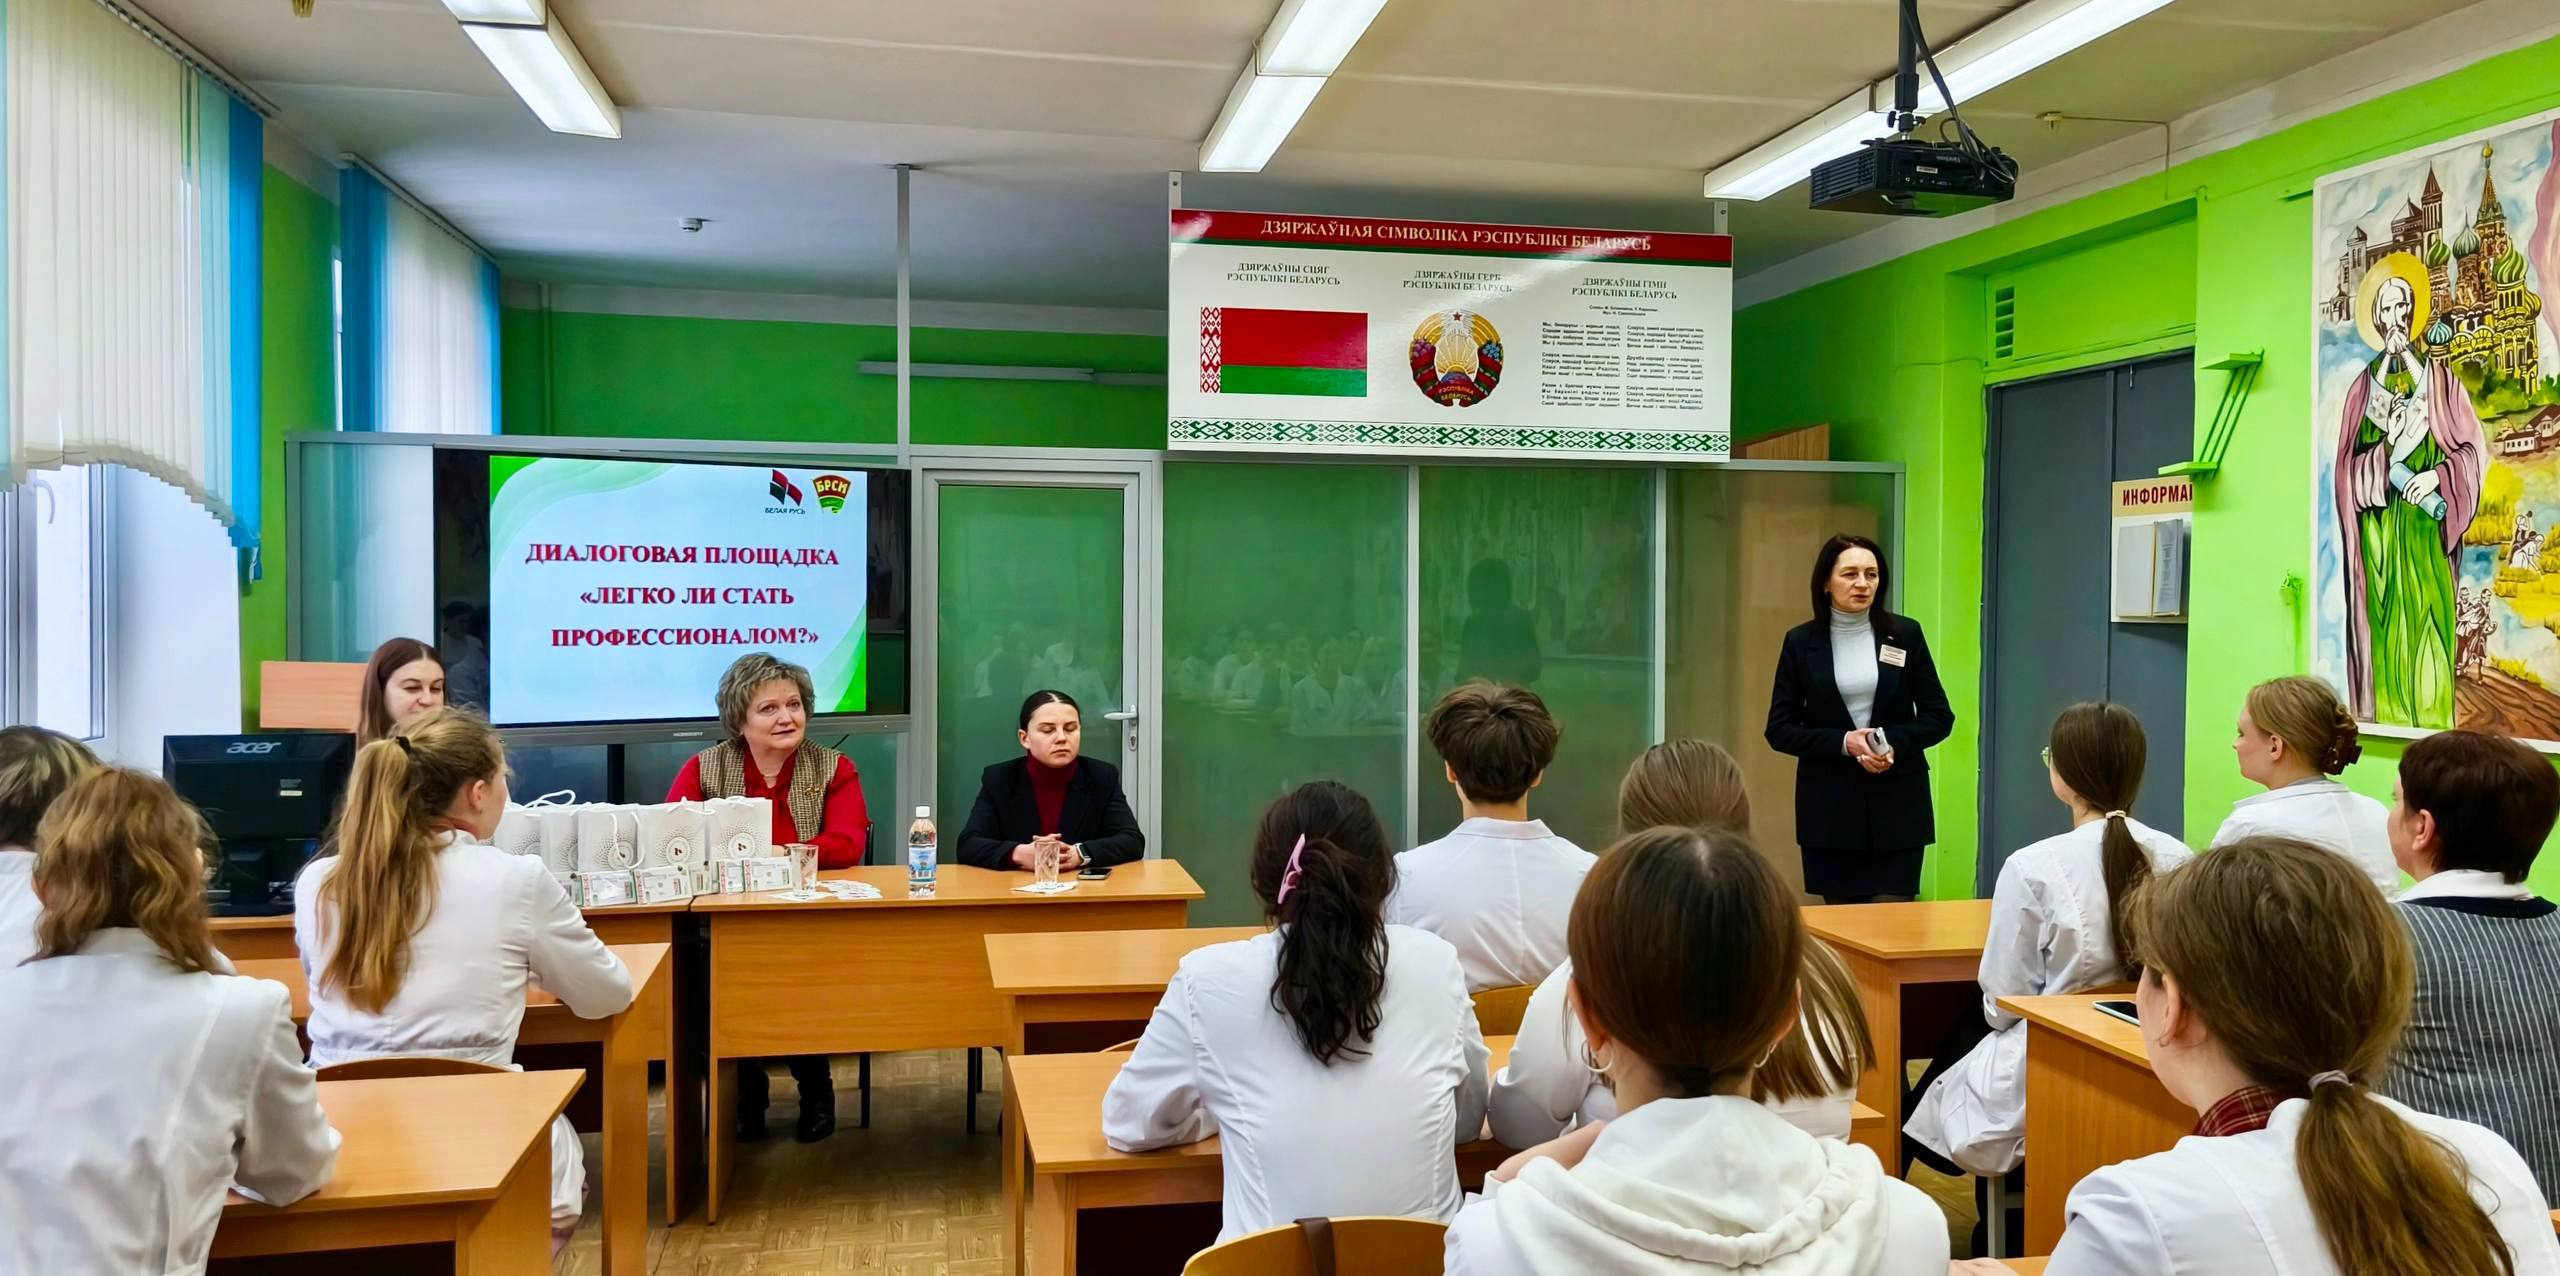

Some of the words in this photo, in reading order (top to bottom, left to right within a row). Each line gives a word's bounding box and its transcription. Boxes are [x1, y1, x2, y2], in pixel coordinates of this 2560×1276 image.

[1261, 220, 1373, 238] ДЗЯРЖАЎНАЯ
[1376, 225, 1468, 243] СІМВОЛІКА
[1473, 230, 1568, 246] РЭСПУБЛІКІ
[1572, 235, 1652, 250] БЕЛАРУСЬ
[1238, 262, 1301, 274] ДЗЯРЖАЎНЫ
[1302, 266, 1330, 275] СЦЯГ
[1227, 273, 1288, 283] РЭСПУБЛІКІ
[1289, 275, 1341, 285] БЕЛАРУСЬ
[1414, 270, 1475, 280] ДЗЯРЖАЎНЫ
[1477, 273, 1502, 281] ГЕРБ
[1403, 280, 1460, 290] РЭСПУБЛІКІ
[1582, 277, 1641, 288] ДЗЯРЖАЎНЫ
[1572, 287, 1628, 297] РЭСПУБЛІКІ
[1629, 289, 1678, 299] БЕЛАРУСЬ
[815, 479, 849, 495] БРСМ
[2122, 484, 2193, 507] ИНФОРМА
[525, 543, 698, 564] ДИАЛОГОВАЯ
[703, 547, 840, 566] ПЛОЩАДКА
[579, 587, 676, 605] «ЛЕГКО
[681, 587, 716, 604] ЛИ
[721, 588, 796, 605] СТАТЬ
[551, 626, 820, 648] ПРОФЕССИОНАЛОМ?»
[226, 741, 283, 754] acer
